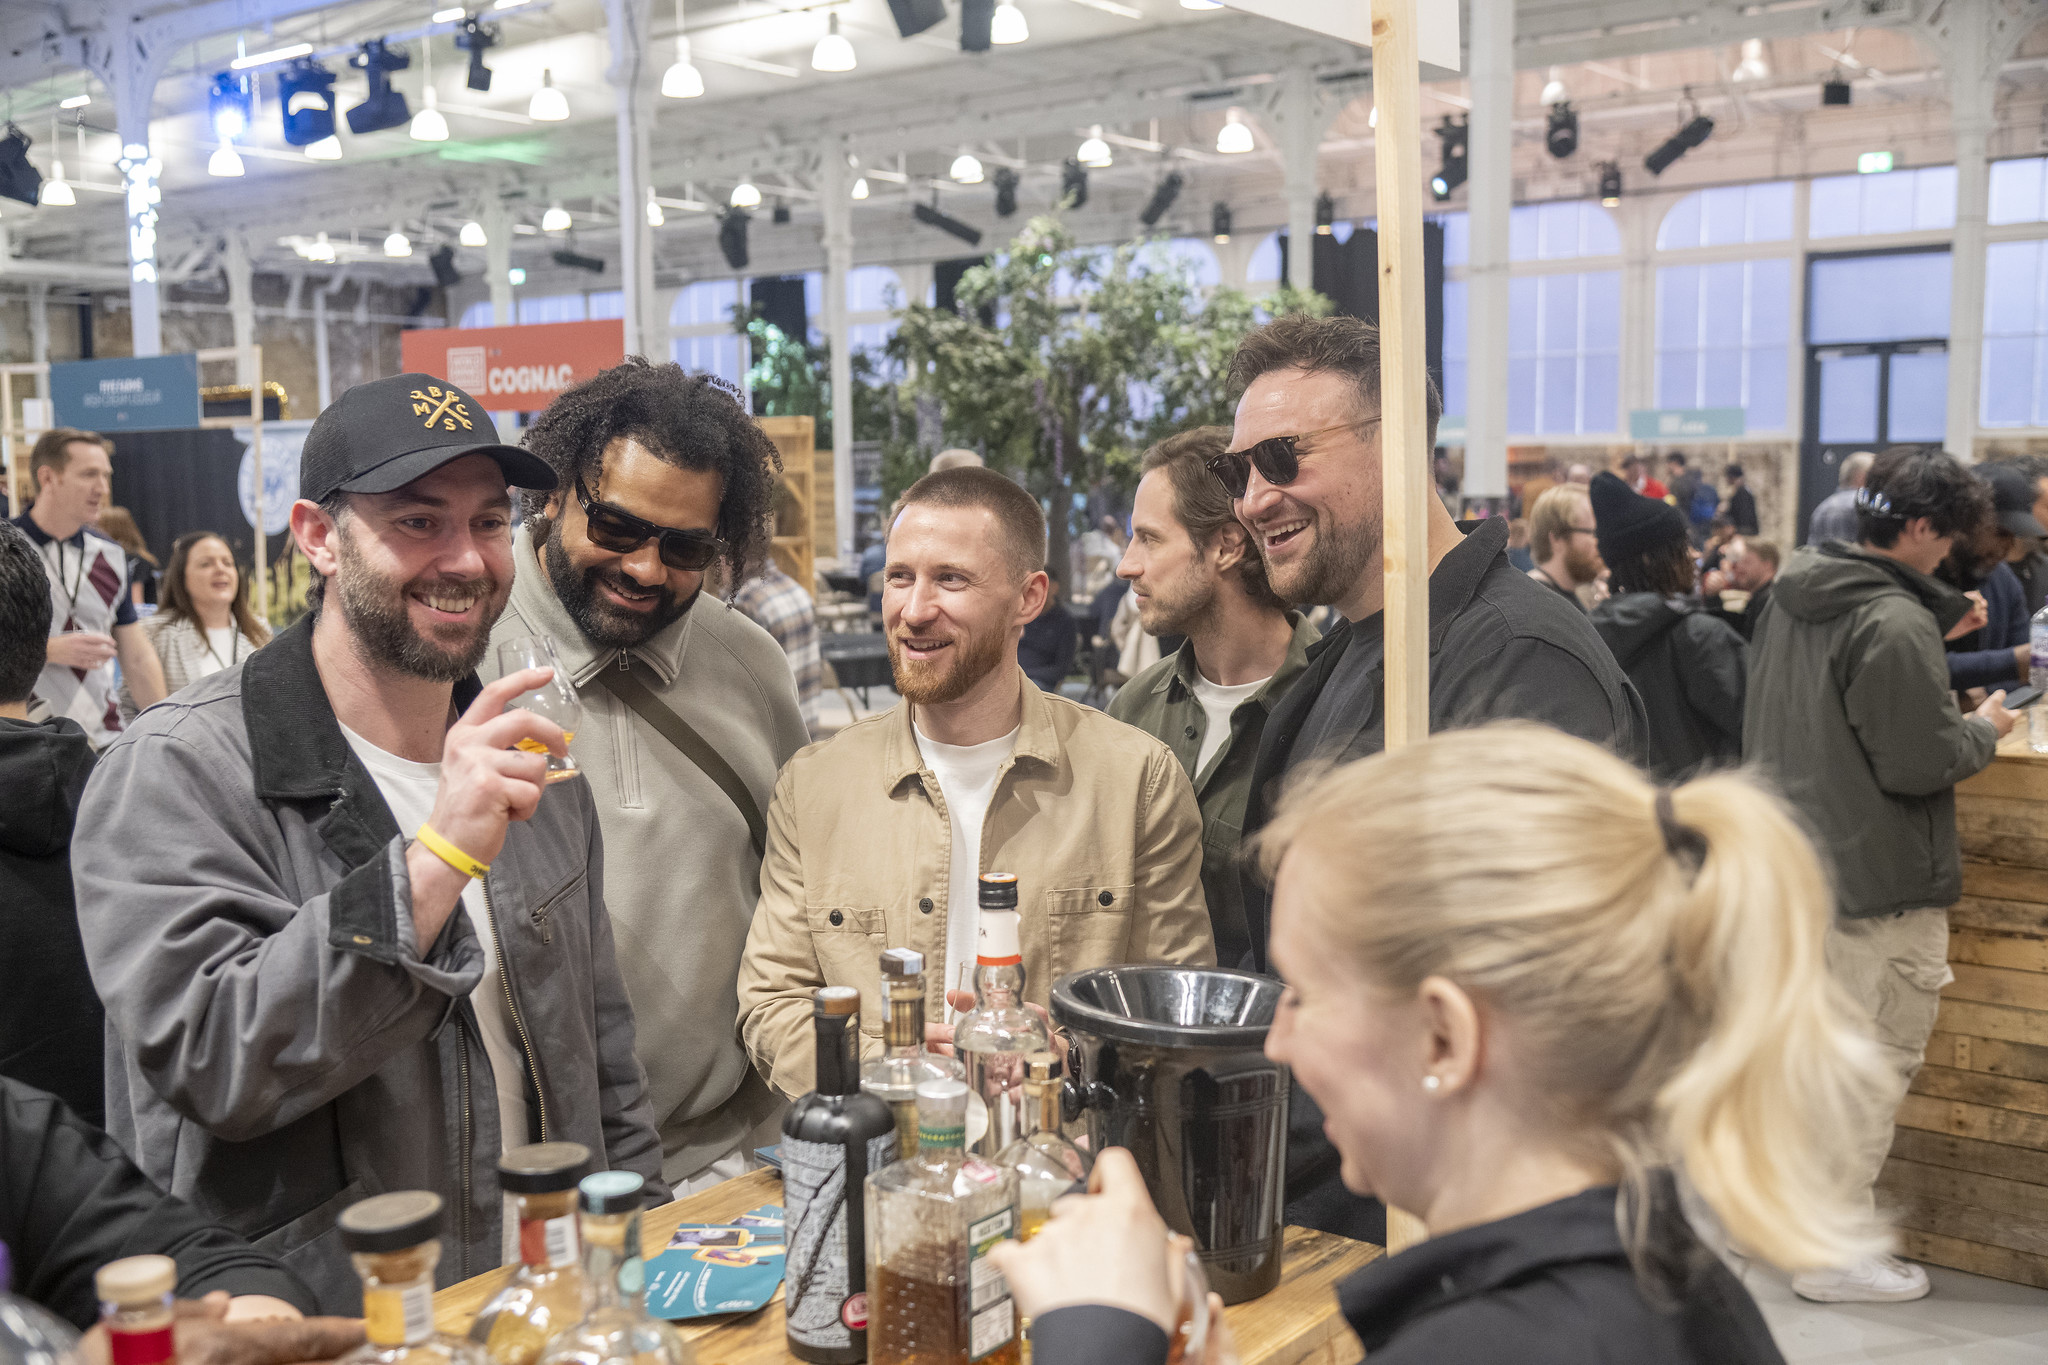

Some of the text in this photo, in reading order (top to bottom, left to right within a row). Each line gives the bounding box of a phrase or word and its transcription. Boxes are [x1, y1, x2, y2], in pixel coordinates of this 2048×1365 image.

[488, 363, 573, 395] COGNAC
[427, 386, 443, 398] B
[412, 402, 469, 417] M C
[443, 418, 457, 431] S
